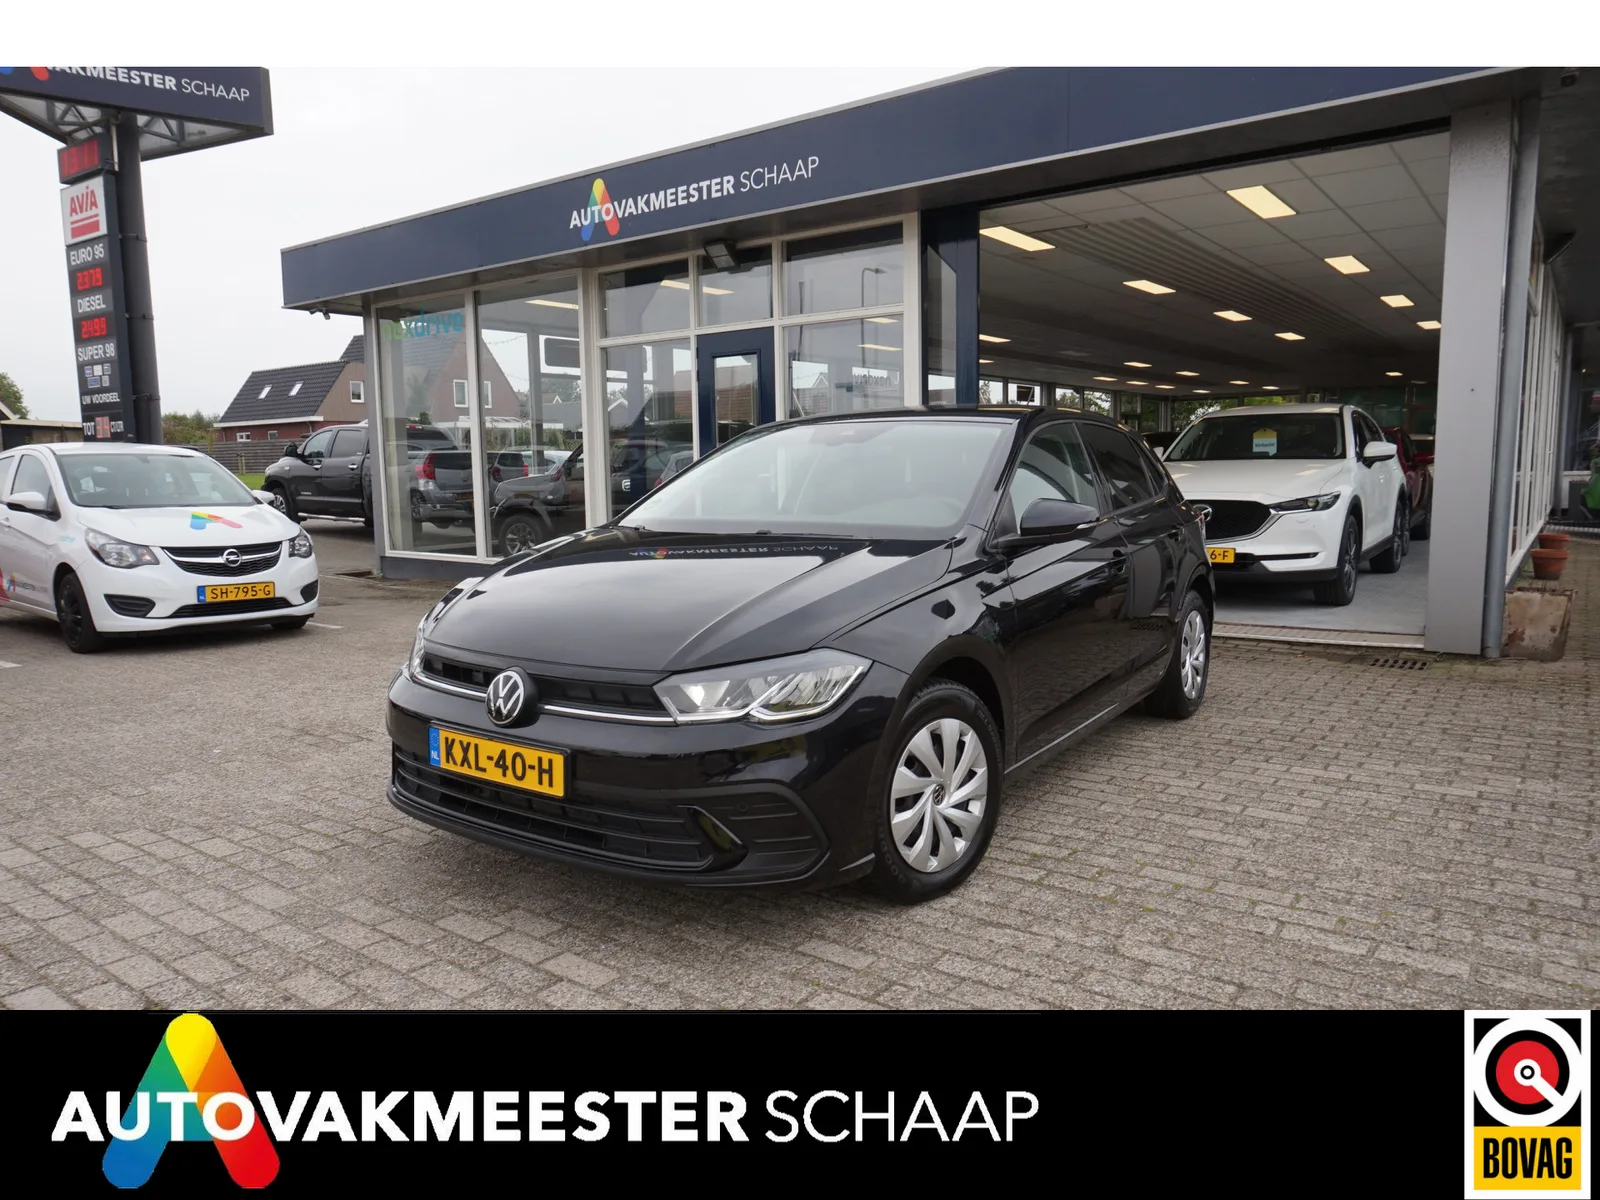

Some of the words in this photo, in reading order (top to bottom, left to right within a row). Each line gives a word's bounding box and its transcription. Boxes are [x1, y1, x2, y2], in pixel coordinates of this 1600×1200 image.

[182, 78, 250, 102] SCHAAP
[569, 175, 735, 229] AUTOVAKMEESTER
[740, 156, 819, 192] SCHAAP
[70, 248, 92, 265] EURO
[94, 243, 104, 259] 95
[77, 294, 106, 313] DIESEL
[77, 344, 104, 362] SUPER
[105, 343, 115, 357] 98
[91, 392, 120, 404] VOORDEEL
[82, 422, 95, 436] TOT
[211, 585, 271, 599] SH-795-G
[431, 750, 440, 760] NL
[444, 736, 553, 788] KXL-40-H
